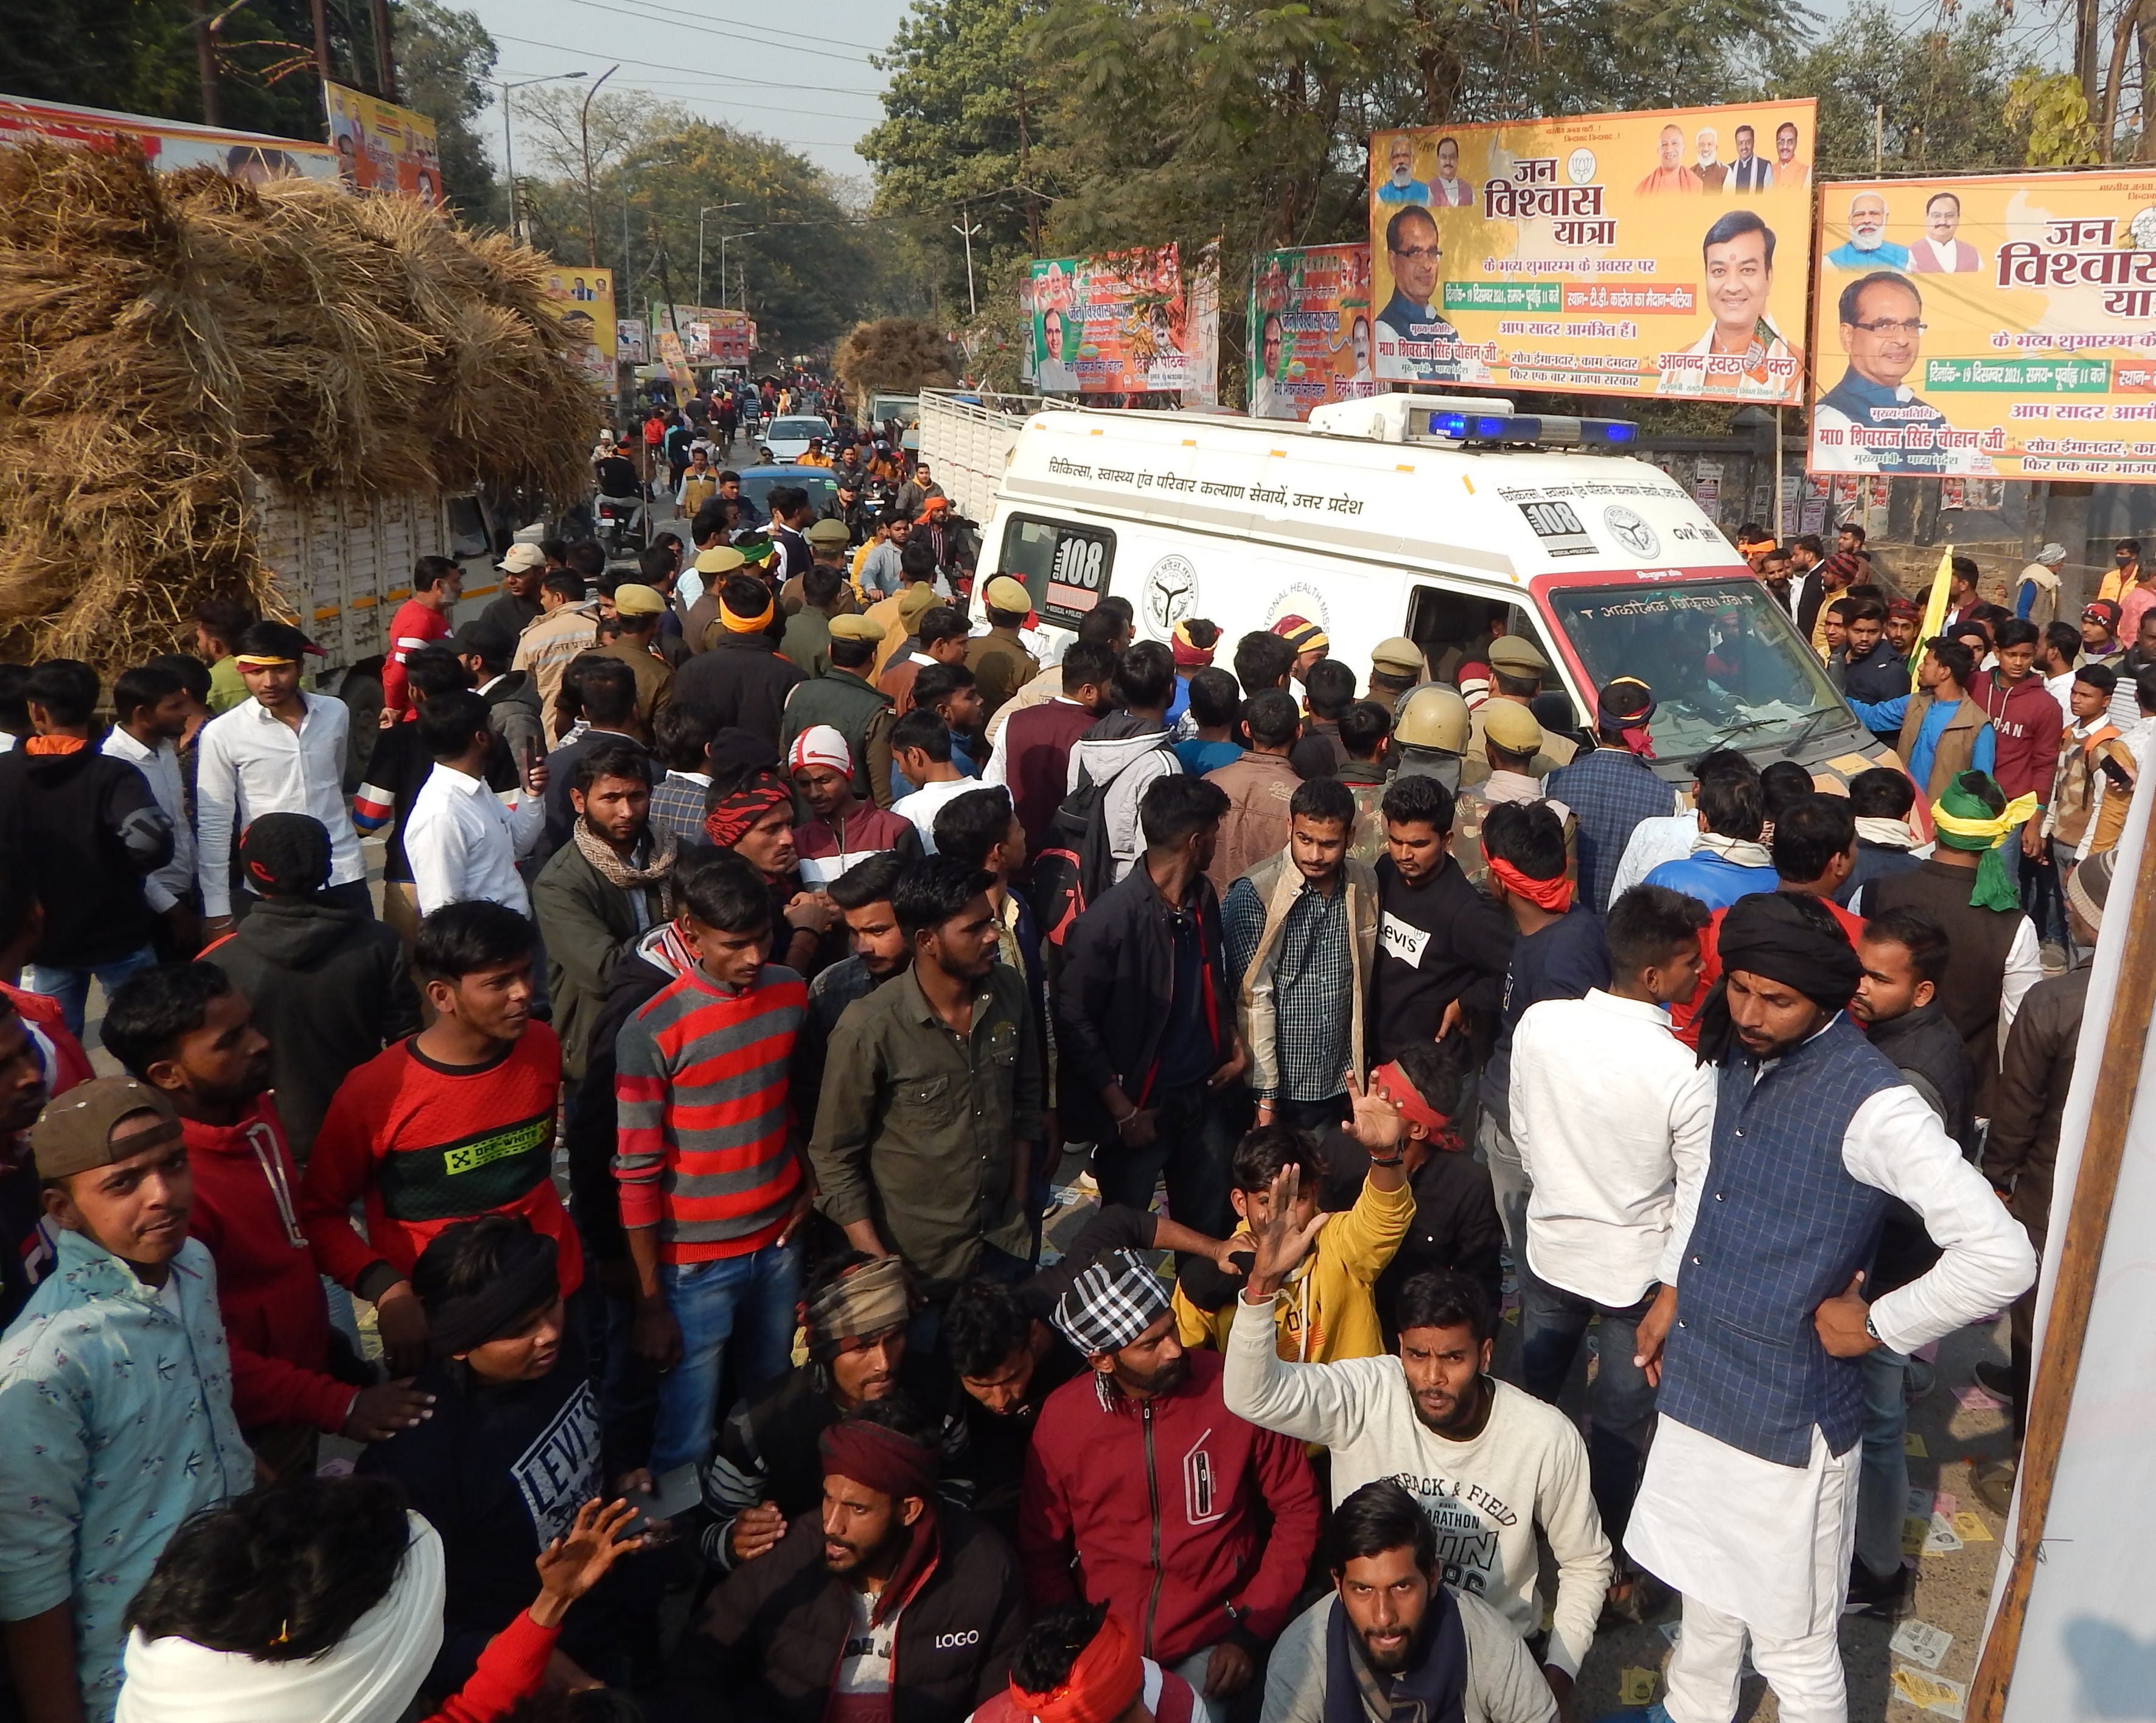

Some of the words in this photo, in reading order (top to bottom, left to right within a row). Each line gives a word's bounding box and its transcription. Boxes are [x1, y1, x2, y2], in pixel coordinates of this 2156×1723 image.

[1513, 159, 1558, 183] जन
[2099, 183, 2129, 191] भारतीय
[1484, 179, 1604, 218] विश्वास
[1553, 220, 1617, 245] यात्रा
[2046, 219, 2116, 246] जन
[1484, 257, 1495, 272] के
[1499, 260, 1522, 272] भव्य
[1526, 260, 1574, 275] शुभारम्भ
[1578, 257, 1590, 272] के
[1595, 260, 1633, 272] अवसर
[1638, 260, 1655, 272] पर
[1068, 305, 1082, 320] जन
[1083, 300, 1111, 320] विश्वास
[1633, 292, 1645, 307] का
[1283, 311, 1295, 327] जन
[1295, 305, 1320, 329] विश्वास
[1320, 311, 1339, 329] यात्रा
[1411, 324, 1428, 335] मुख्य
[1499, 322, 1524, 334] आप
[1529, 323, 1560, 335] सादर
[1565, 321, 1616, 337] आमंत्रित
[1398, 338, 1431, 358] शिवराज
[1434, 338, 1452, 359] सिंह
[1453, 340, 1481, 360] चौहान
[1483, 342, 1496, 360] जी
[1992, 331, 2011, 347] के
[2016, 335, 2053, 348] भव्य
[2059, 334, 2133, 352] शुभारम्भ
[2139, 330, 2156, 347] के
[1511, 351, 1530, 364] सोच
[1581, 356, 1603, 367] काम
[1606, 357, 1638, 369] दमदार
[1659, 354, 1704, 371] आनन्द
[1767, 358, 1795, 376] क्ल
[1509, 368, 1528, 380] फिर
[1532, 371, 1547, 381] एक
[1570, 374, 1600, 385] भाजपा
[1604, 376, 1639, 386] सरकार
[1962, 368, 1972, 383] 19
[1972, 360, 2004, 383] दिसम्बर
[2090, 362, 2107, 384] बजे
[1334, 373, 1354, 396] दिनेश
[1871, 408, 1897, 421] मुख्य
[2011, 405, 2050, 418] आप
[2055, 406, 2106, 420] सादर
[1849, 425, 1900, 447] शिवराज
[1905, 425, 1932, 447] सिंह
[1937, 426, 1979, 449] चौहान
[1984, 427, 2005, 449] जी
[2026, 437, 2056, 452] सोच
[2061, 438, 2127, 456] ईमानदार,
[1932, 453, 1958, 466] प्रदेश
[2023, 456, 2051, 470] फिर
[2056, 461, 2080, 472] एक
[1048, 456, 1093, 481] चिकित्सा,
[1097, 467, 1135, 484] स्वास्थ्य
[1157, 471, 1198, 492] परिवार
[1200, 481, 1246, 500] कल्याण
[1249, 481, 1288, 508] सेवायें,
[1293, 493, 1324, 509] उत्तर
[1327, 492, 1364, 515] प्रदेश
[1526, 502, 1582, 534] 108
[1673, 526, 1700, 540] GVK
[1052, 551, 1063, 580] CALL
[1059, 537, 1103, 589] 108
[1290, 581, 1322, 603] HEALTH
[475, 1130, 537, 1156] OFF-WHITE
[1451, 1481, 1461, 1497] &
[1467, 1484, 1518, 1526] FIELD
[935, 1630, 980, 1649] LOGO
